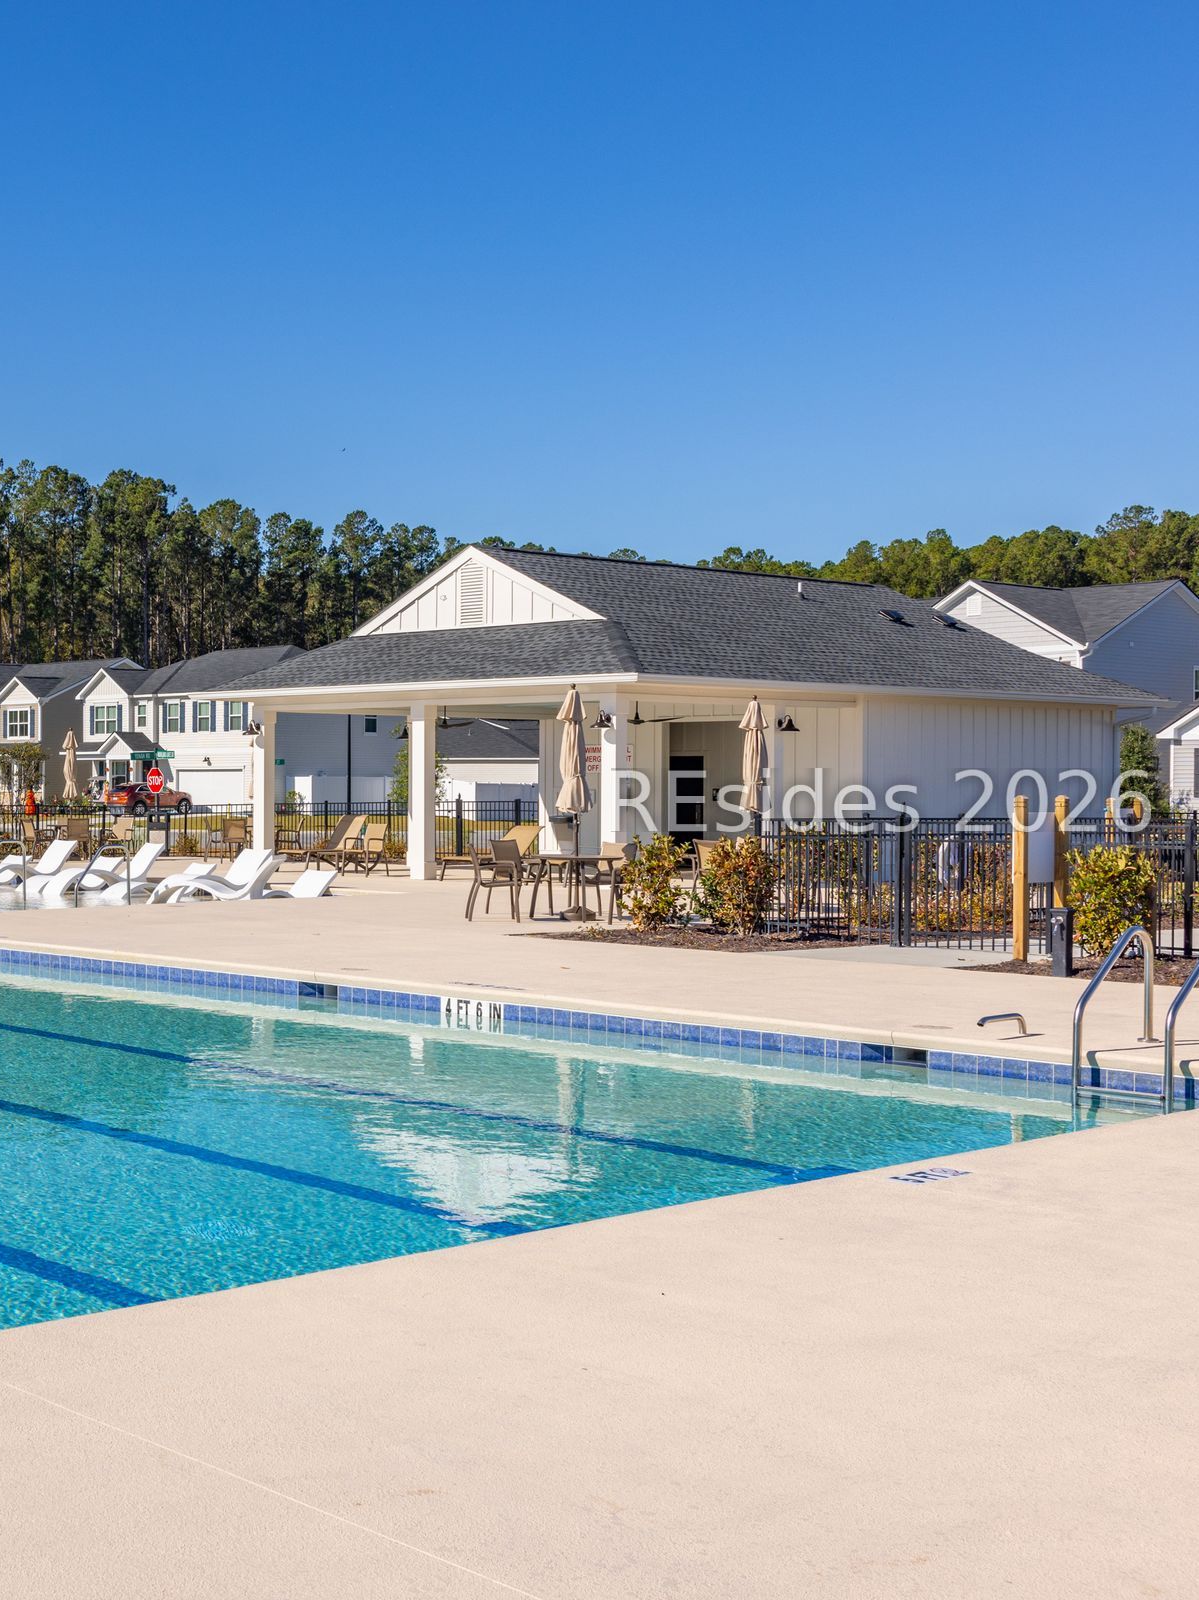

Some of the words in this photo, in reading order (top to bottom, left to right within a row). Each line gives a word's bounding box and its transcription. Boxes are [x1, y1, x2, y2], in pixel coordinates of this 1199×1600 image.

[148, 776, 162, 785] STOP
[445, 998, 451, 1013] 4
[457, 999, 470, 1015] FT
[476, 1001, 482, 1016] 6
[489, 1002, 502, 1018] IN
